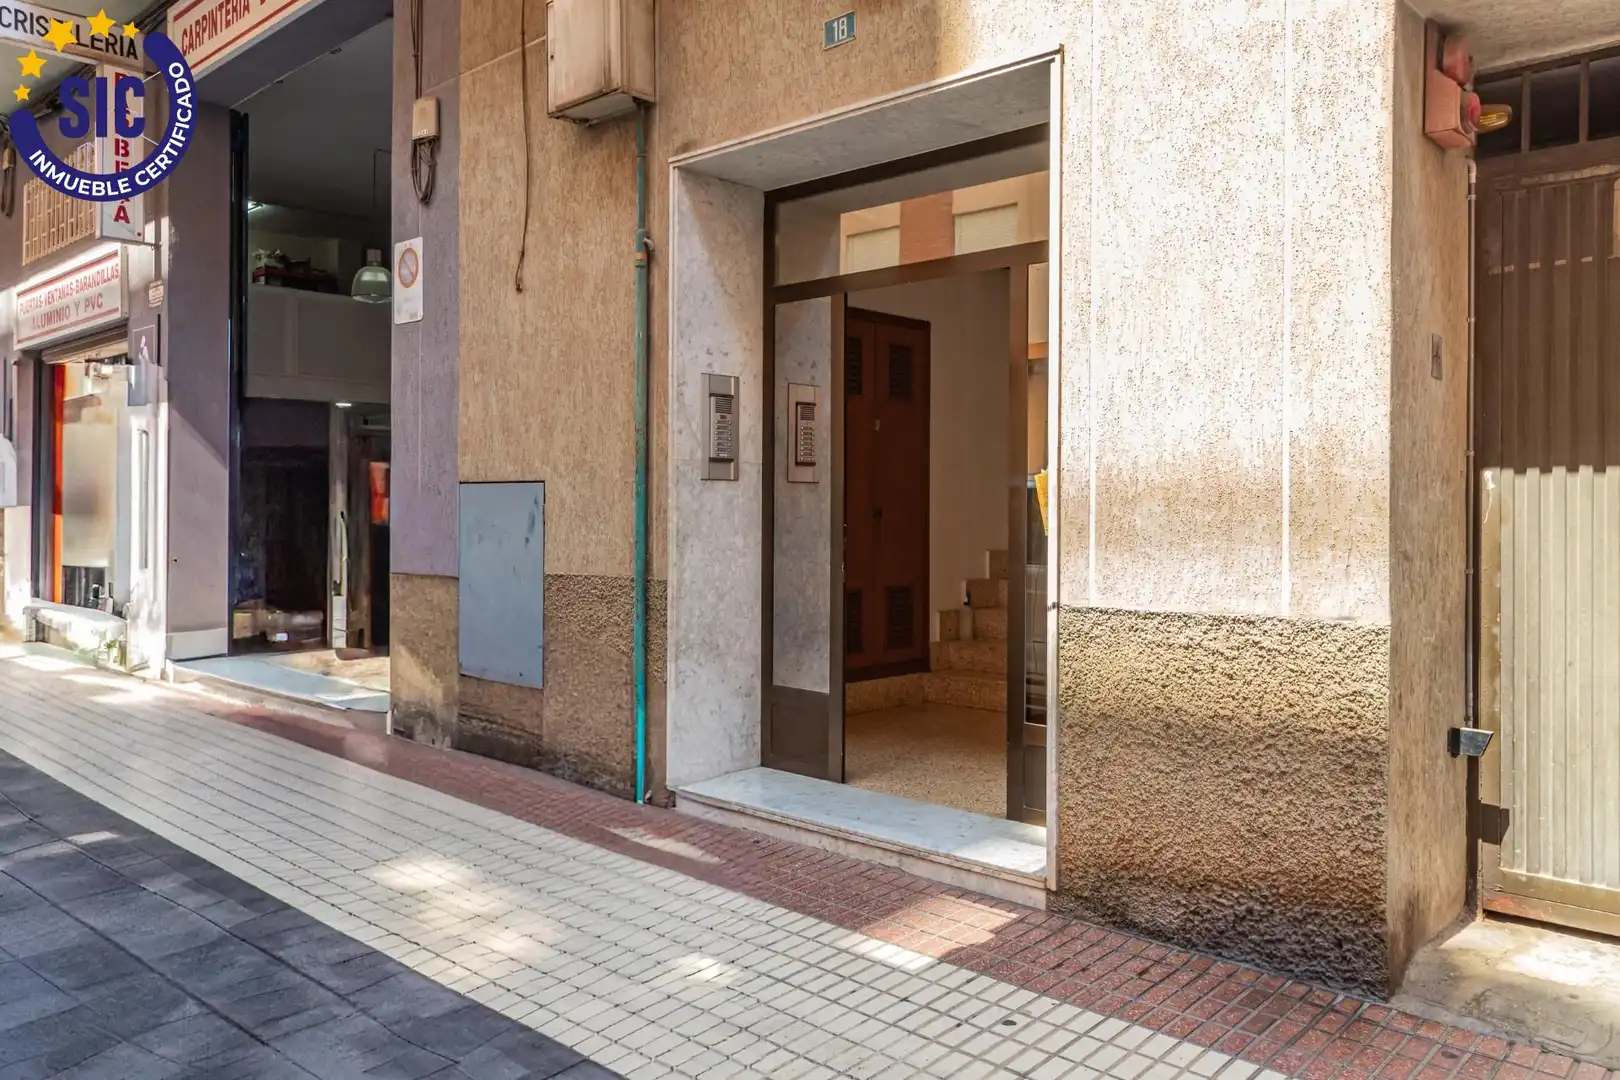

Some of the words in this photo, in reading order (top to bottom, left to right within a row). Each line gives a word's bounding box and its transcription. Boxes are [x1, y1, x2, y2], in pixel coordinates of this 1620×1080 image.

[0, 6, 139, 60] CRISLERIA
[32, 303, 71, 330] ALUMINIO
[74, 299, 81, 316] Y
[84, 292, 104, 313] PVC
